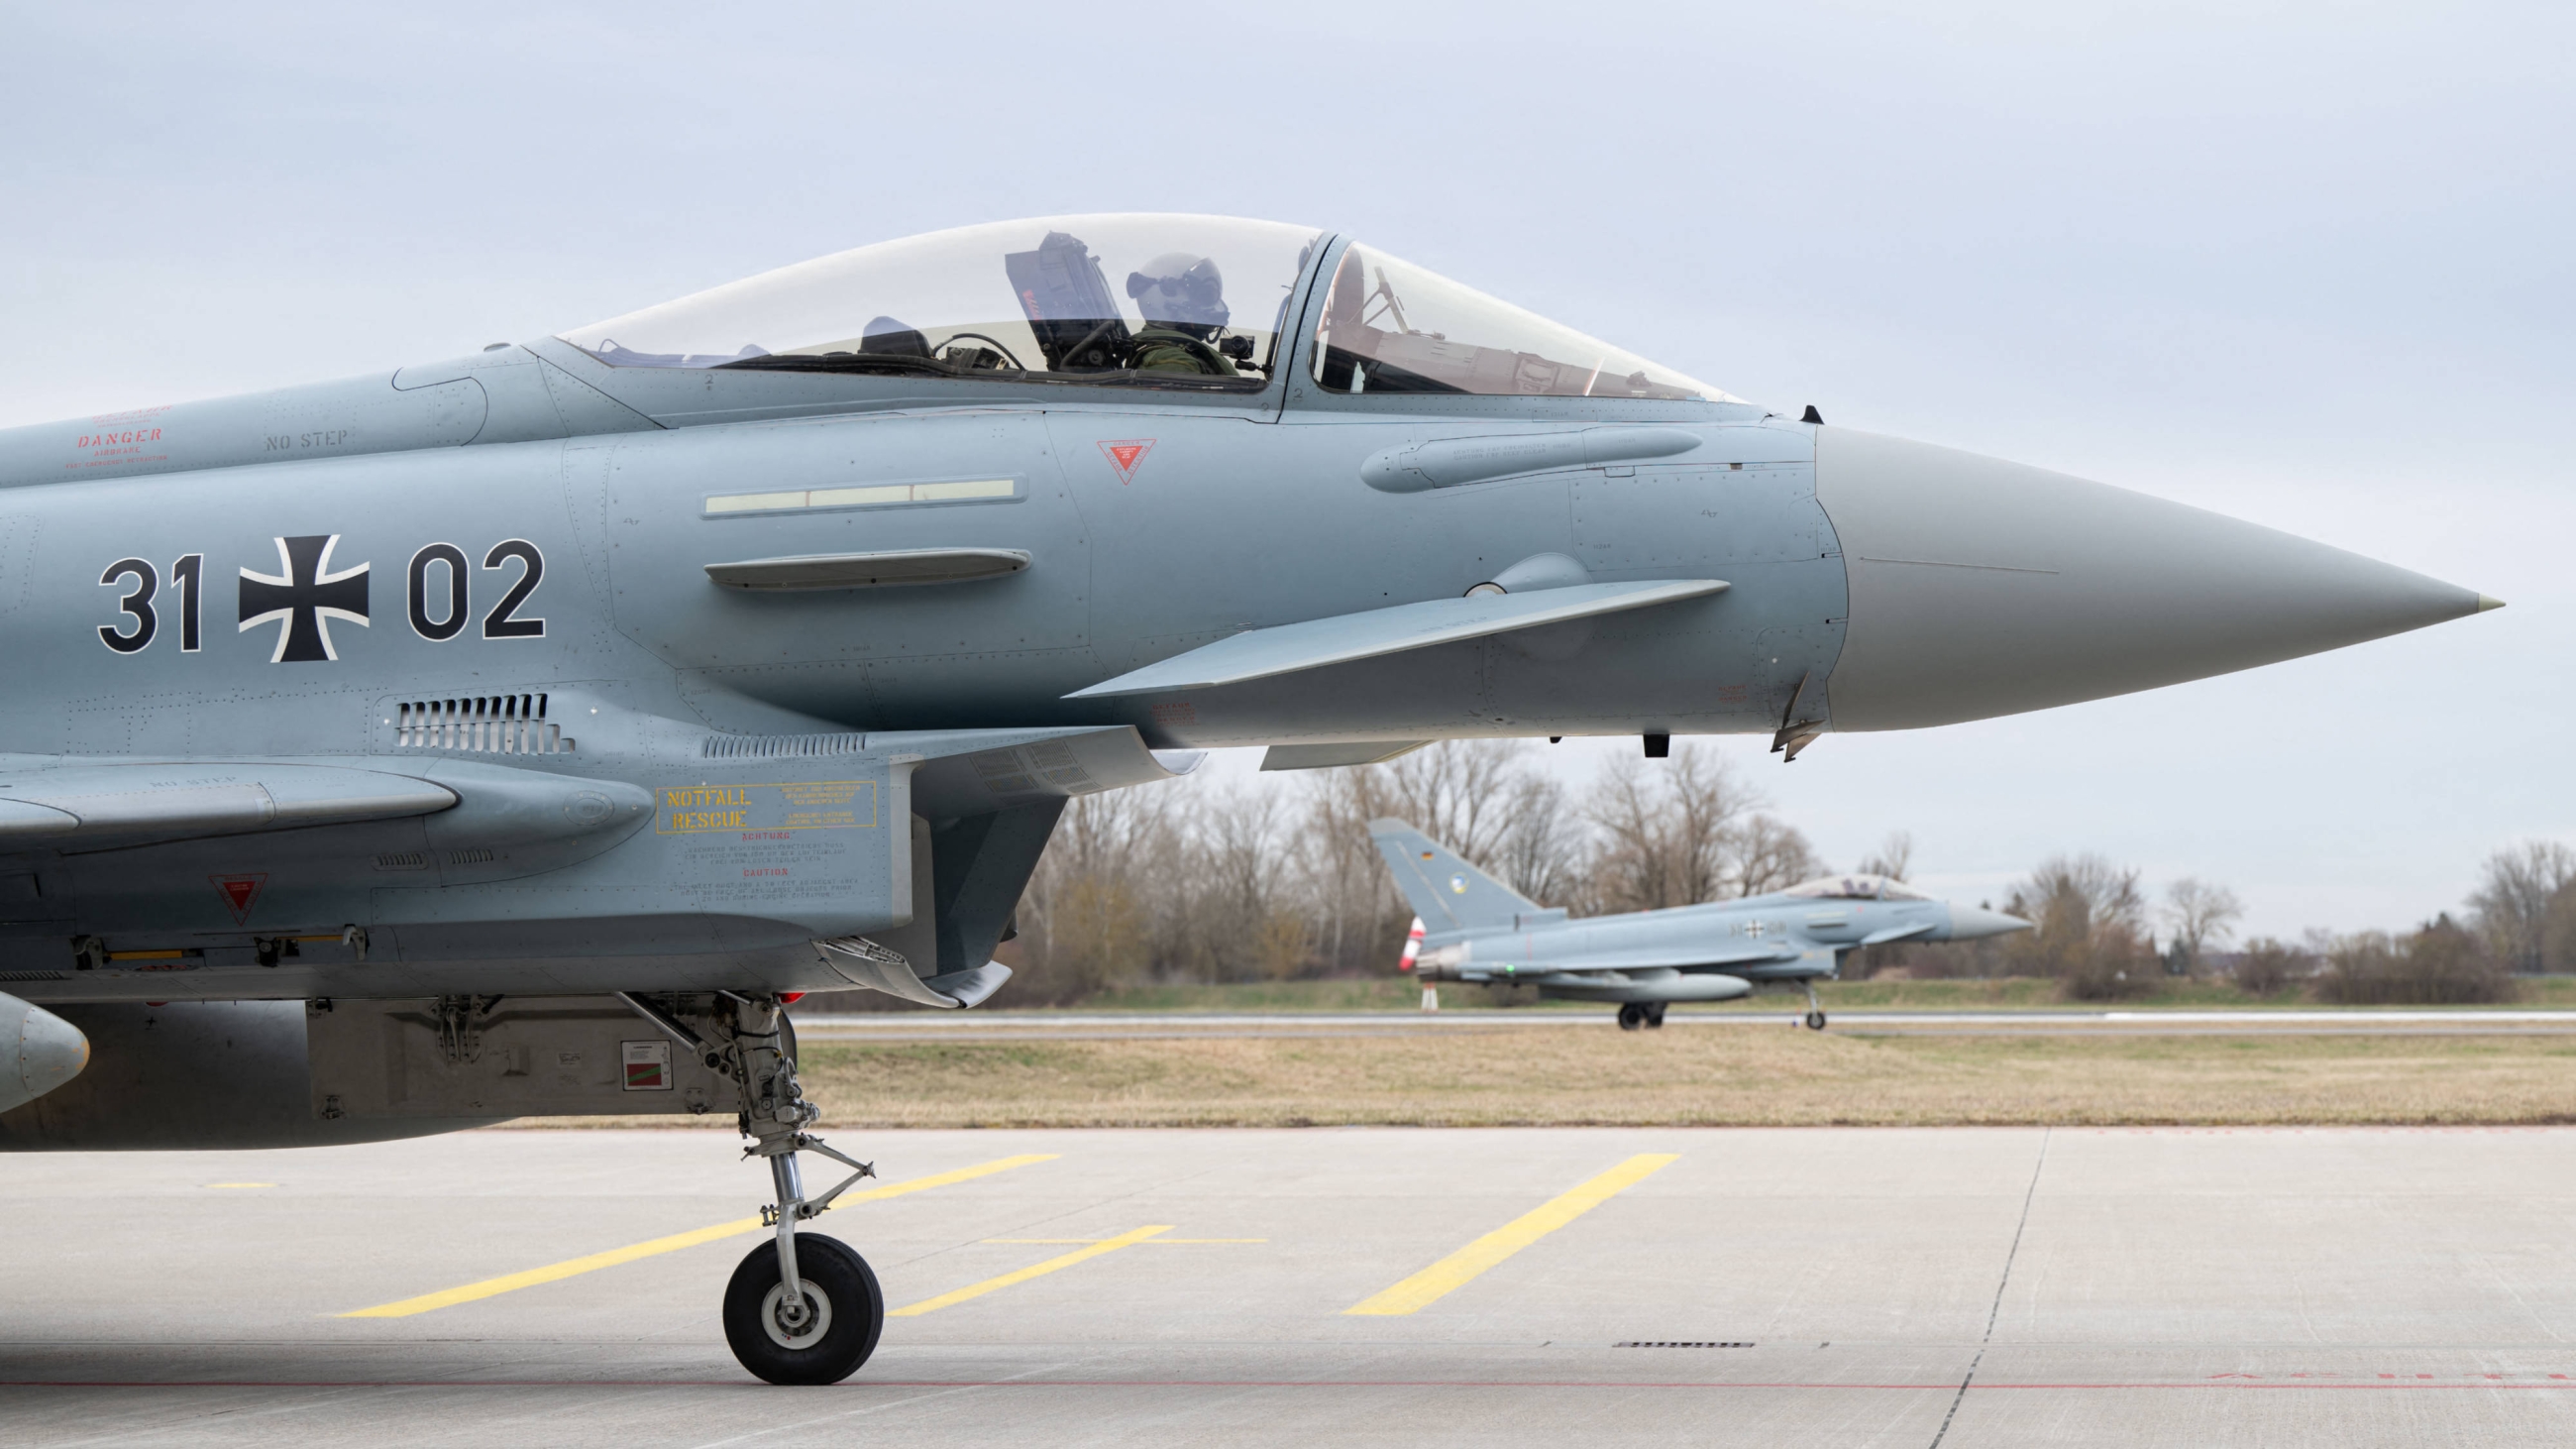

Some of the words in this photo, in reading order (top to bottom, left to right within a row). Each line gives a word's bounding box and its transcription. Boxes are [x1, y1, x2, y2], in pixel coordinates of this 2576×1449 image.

[1294, 388, 1304, 398] 2
[77, 428, 162, 448] DANGER
[267, 435, 291, 451] NO
[300, 430, 348, 448] STEP
[94, 446, 141, 457] AIRBRAKE
[97, 553, 204, 655] 31
[406, 538, 547, 642] 02
[186, 775, 237, 785] STEP
[667, 789, 752, 807] NOTFALL
[673, 810, 747, 829] RESCUE
[741, 832, 791, 841] ACHTUNG
[743, 868, 789, 877] CAUTION
